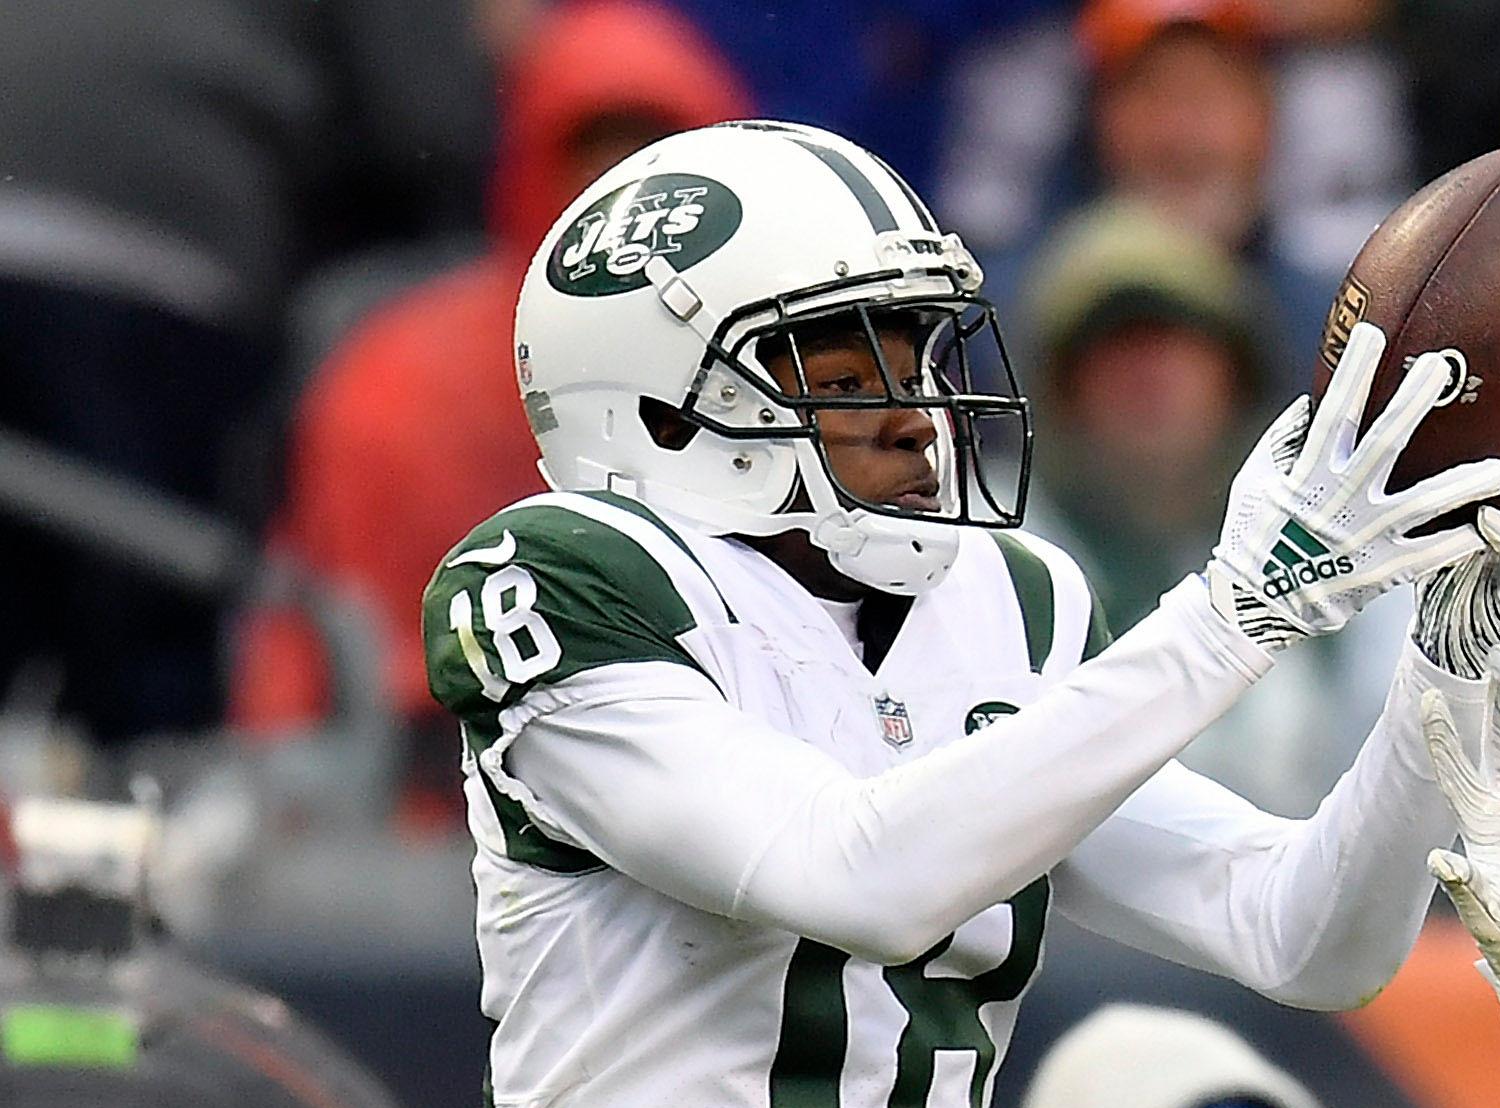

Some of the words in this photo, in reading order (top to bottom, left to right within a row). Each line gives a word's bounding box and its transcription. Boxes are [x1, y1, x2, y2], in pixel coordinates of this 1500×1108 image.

[562, 204, 705, 268] JETS
[1263, 556, 1354, 599] adidas
[449, 564, 562, 703] 18
